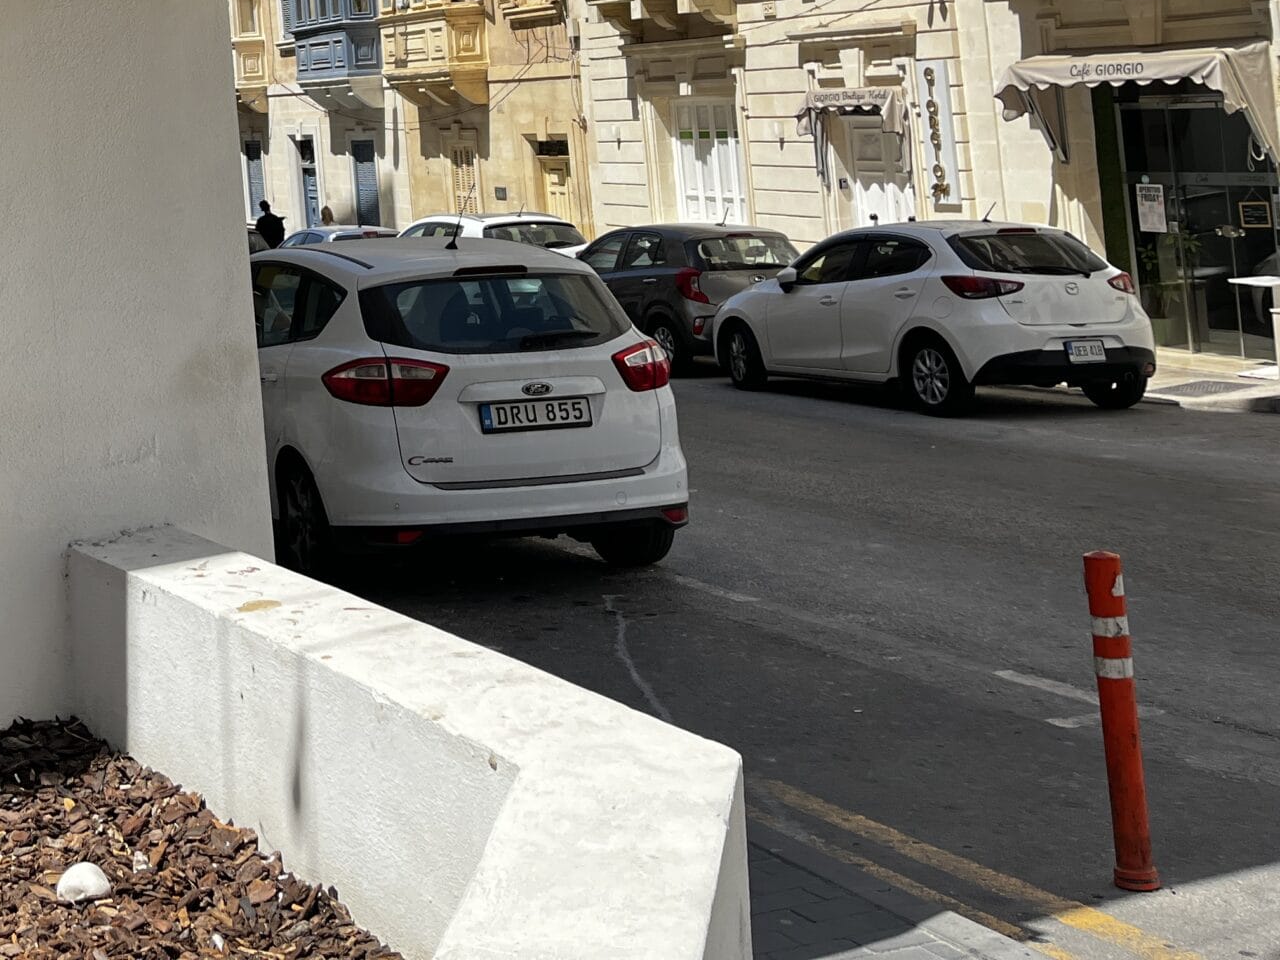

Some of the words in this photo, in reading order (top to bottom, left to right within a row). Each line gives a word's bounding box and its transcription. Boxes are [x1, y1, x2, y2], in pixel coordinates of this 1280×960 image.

[1095, 62, 1144, 76] GIORGIO
[813, 93, 840, 103] GIORGIO
[495, 403, 538, 426] DRU
[545, 401, 584, 422] 855
